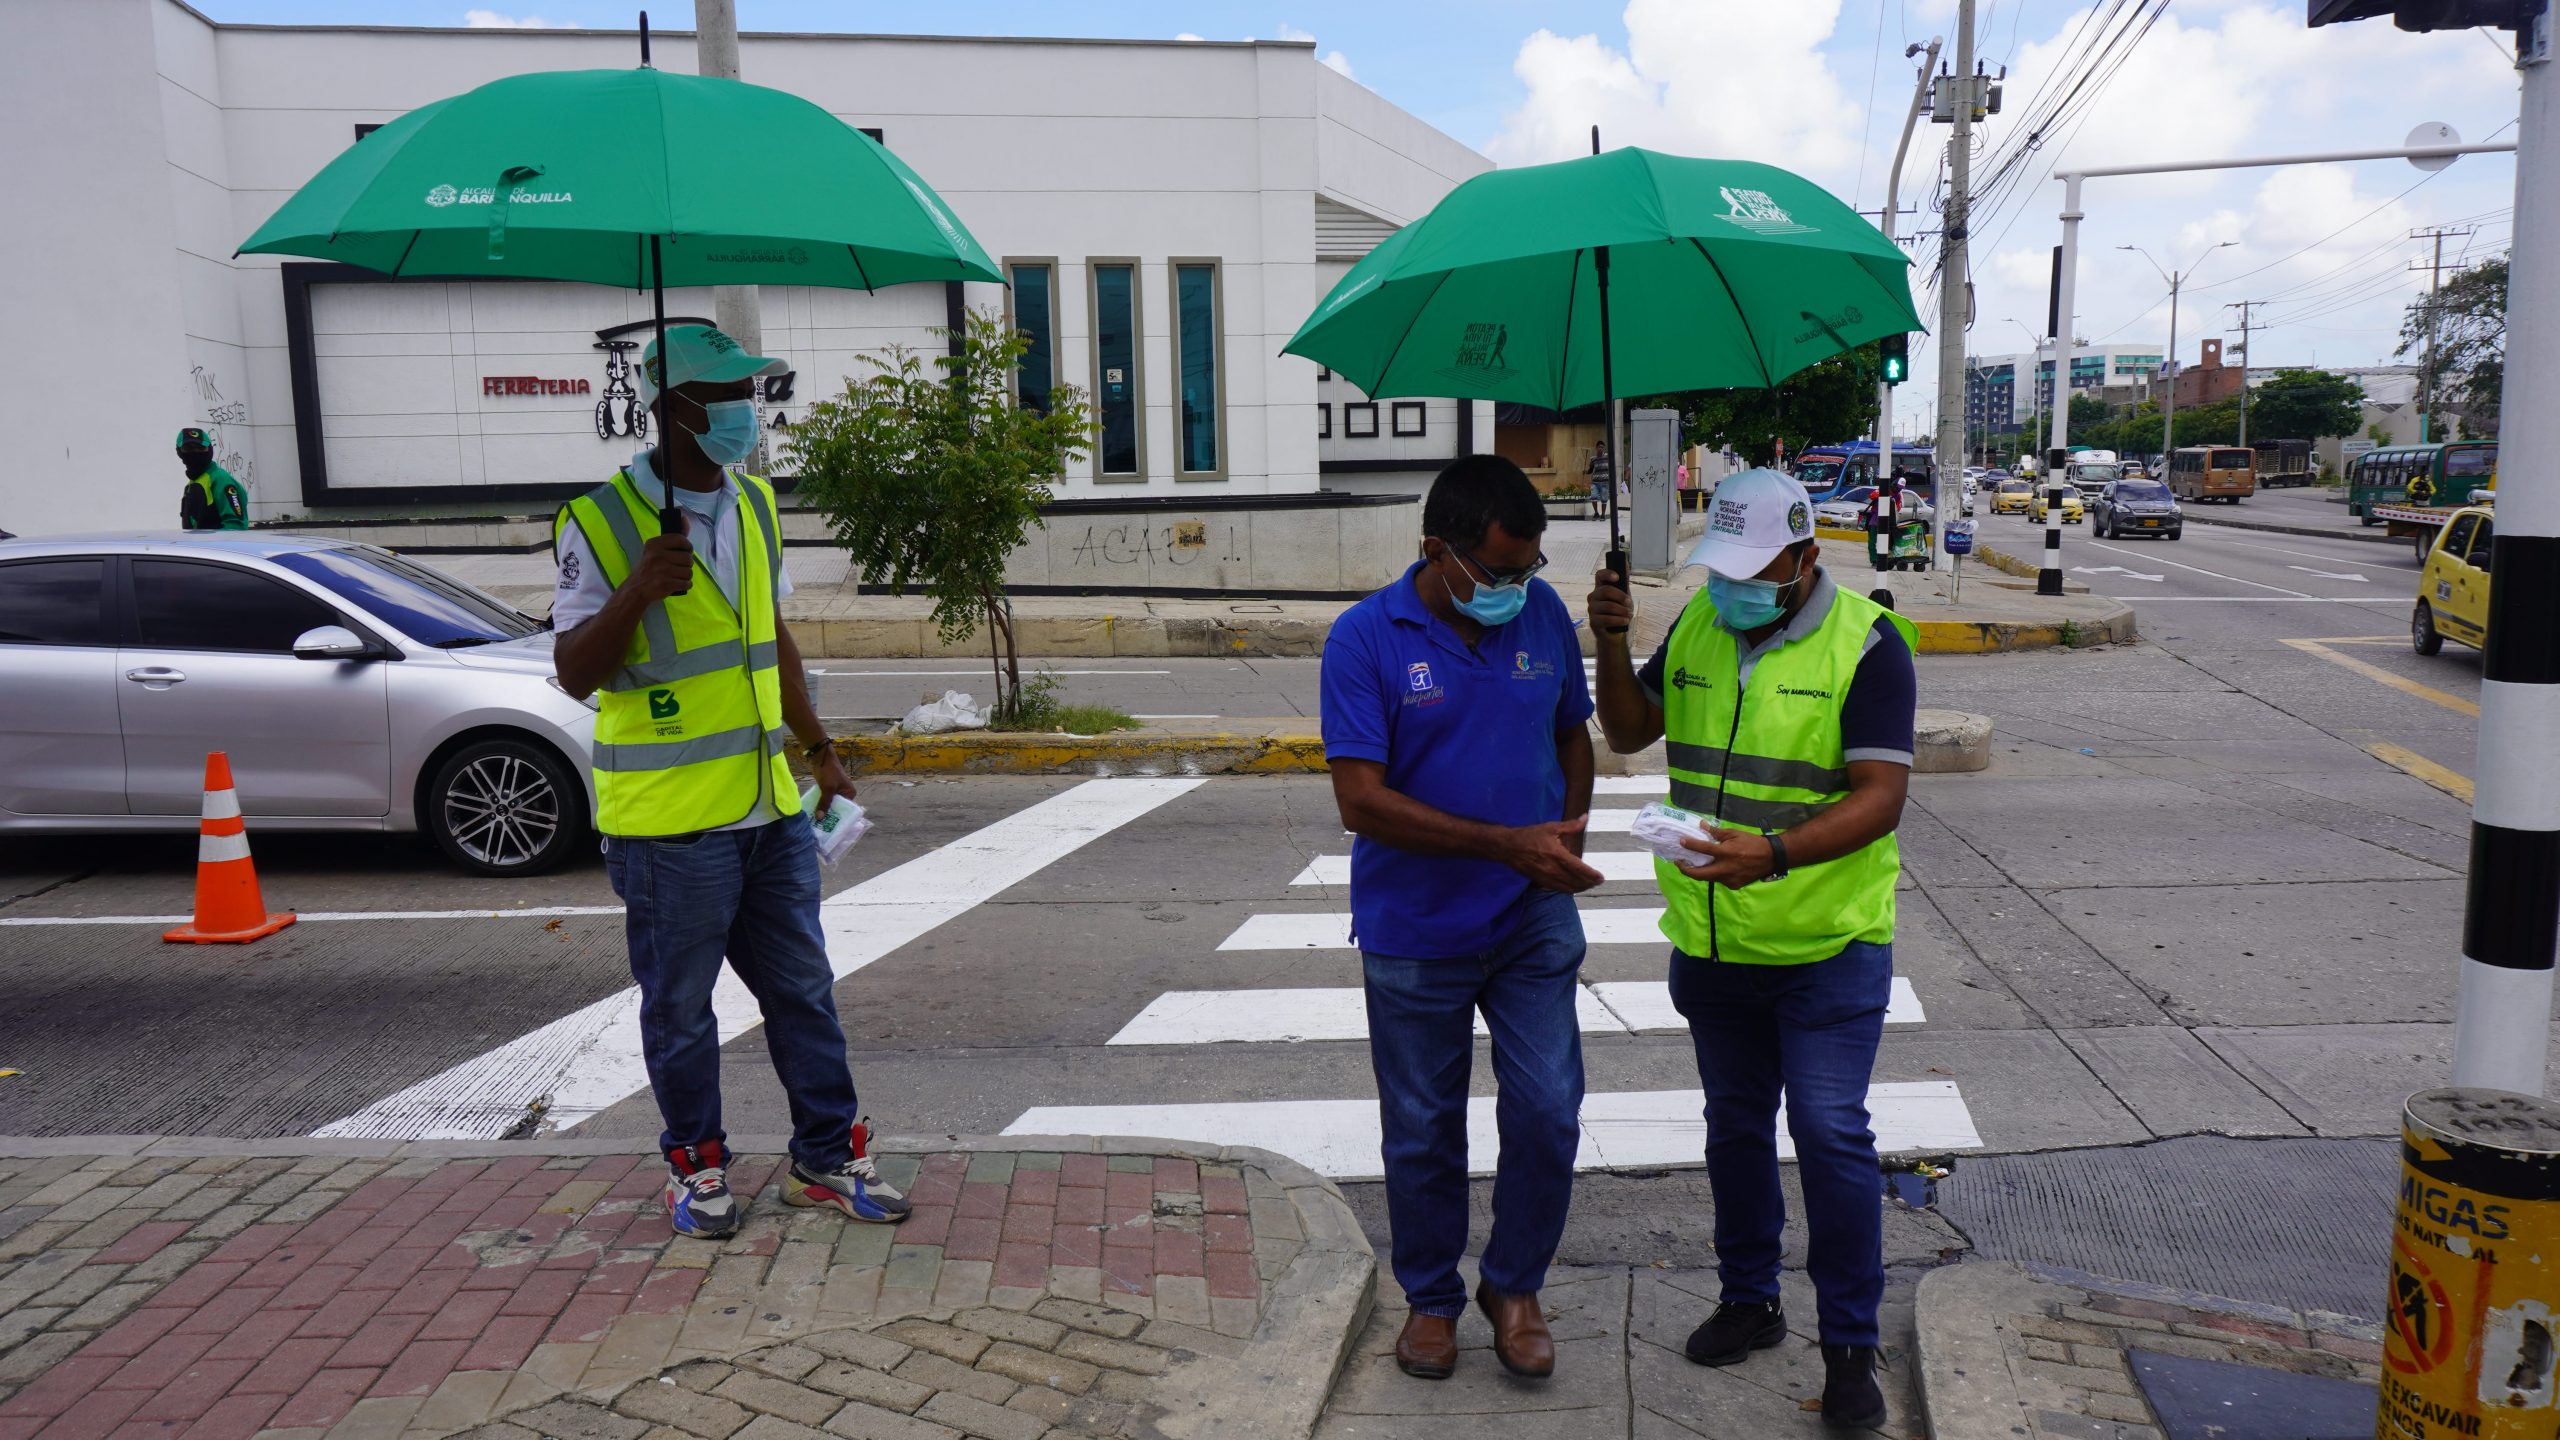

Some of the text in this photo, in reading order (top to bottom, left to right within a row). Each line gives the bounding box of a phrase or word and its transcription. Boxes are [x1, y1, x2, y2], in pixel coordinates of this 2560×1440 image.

[459, 193, 572, 204] BARRNQUILLA
[483, 376, 590, 396] FERRETERIA
[2413, 1222, 2499, 1265] NATAL
[2391, 1379, 2482, 1437] EXCAVAR
